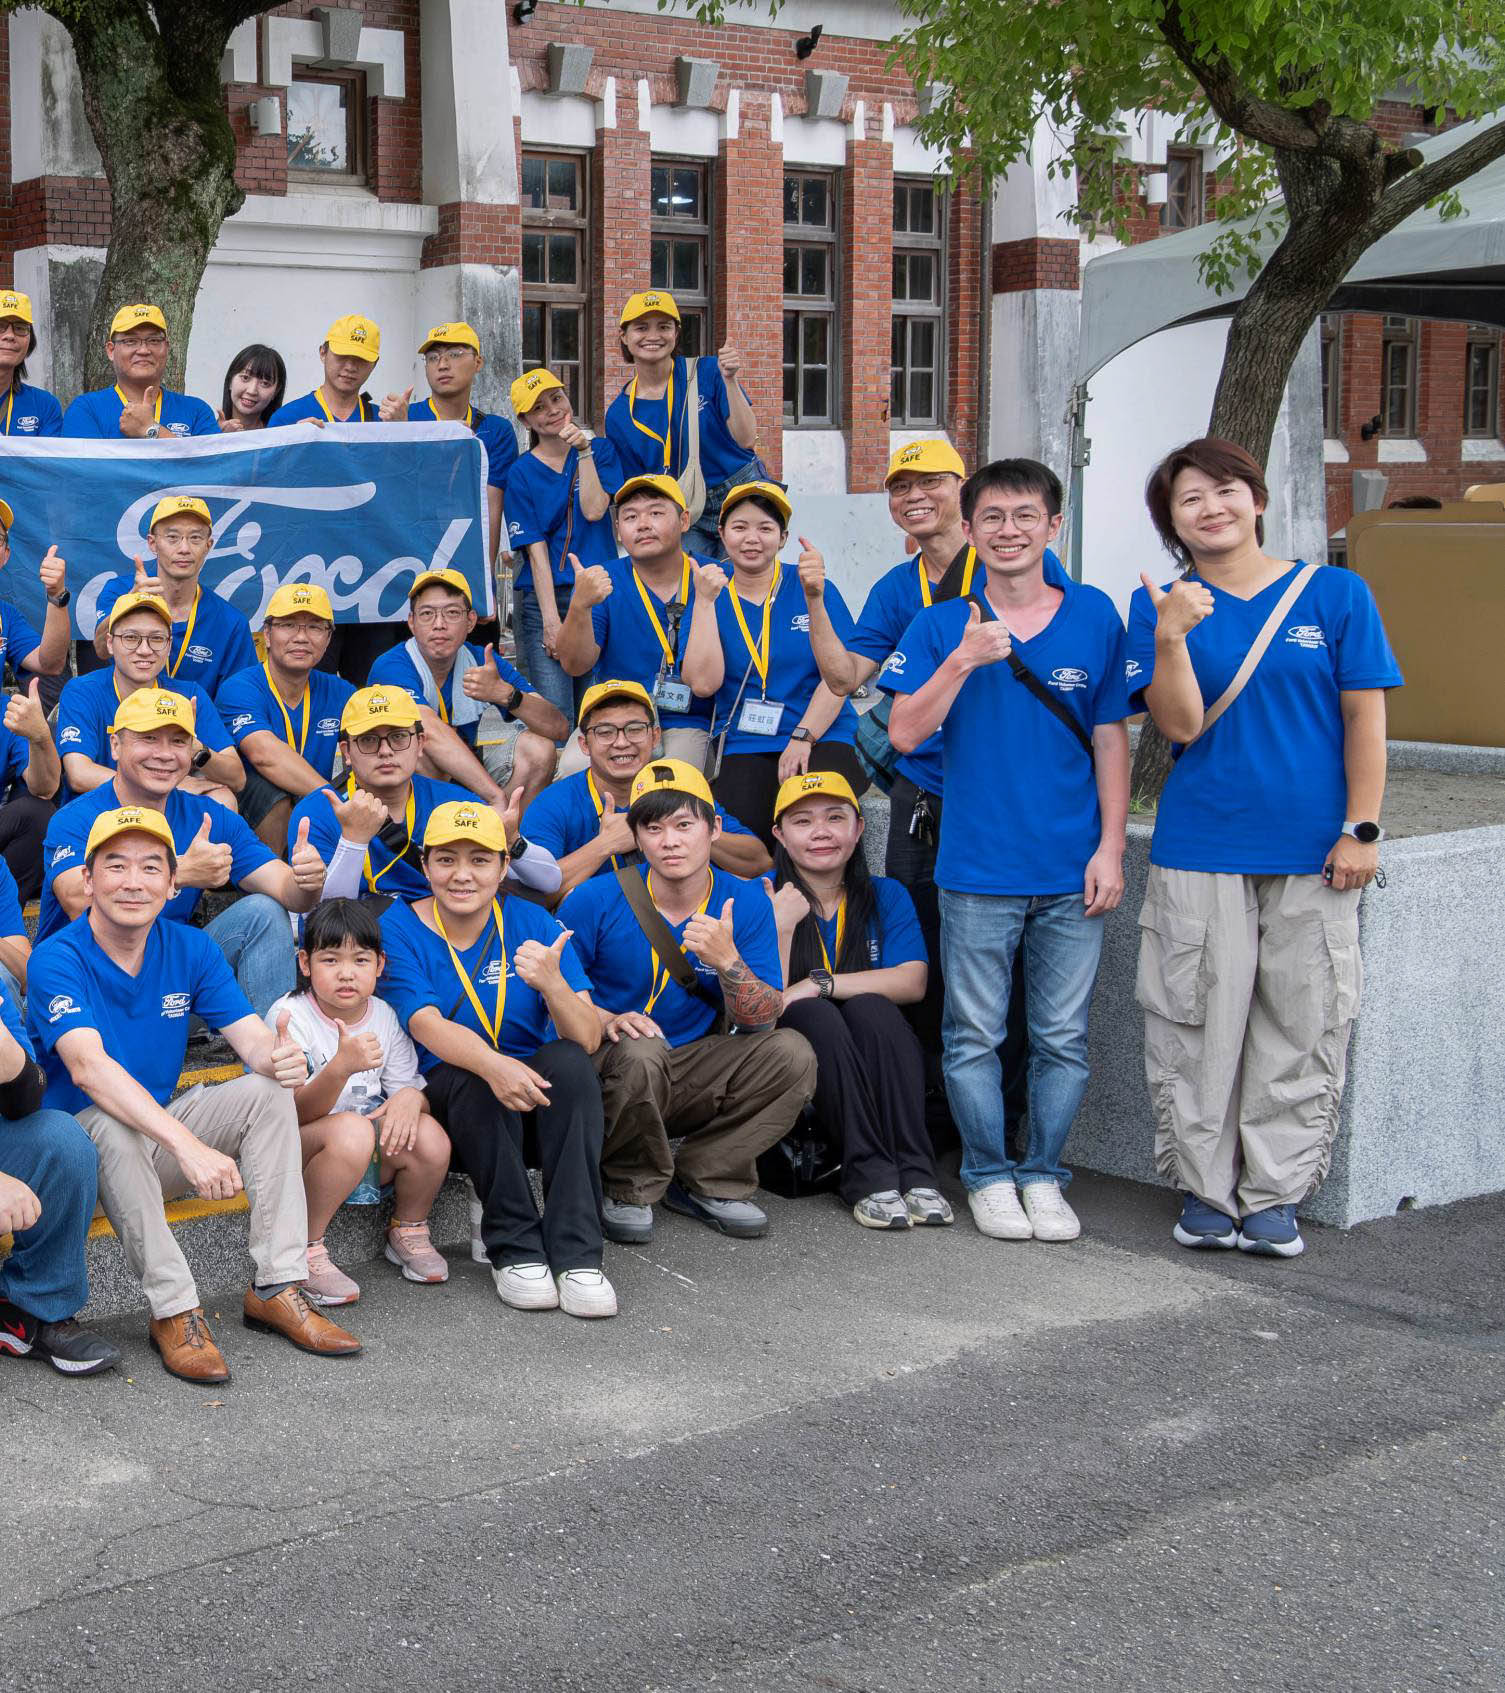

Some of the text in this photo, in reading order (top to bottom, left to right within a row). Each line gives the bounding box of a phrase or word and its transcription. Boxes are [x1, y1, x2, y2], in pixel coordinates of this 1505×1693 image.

[2, 302, 18, 310] SAFE
[350, 335, 365, 344] SAFE
[527, 379, 542, 390] SAFE
[900, 453, 921, 464] SAFE
[76, 482, 473, 640] Ford
[1295, 627, 1323, 639] Ford
[1059, 670, 1083, 681] Ford
[156, 708, 177, 716] SAFE
[369, 705, 390, 714] SAFE
[801, 782, 823, 791] SAFE
[117, 817, 141, 825] SAFE
[454, 819, 478, 828] SAFE
[163, 995, 186, 1007] Ford
